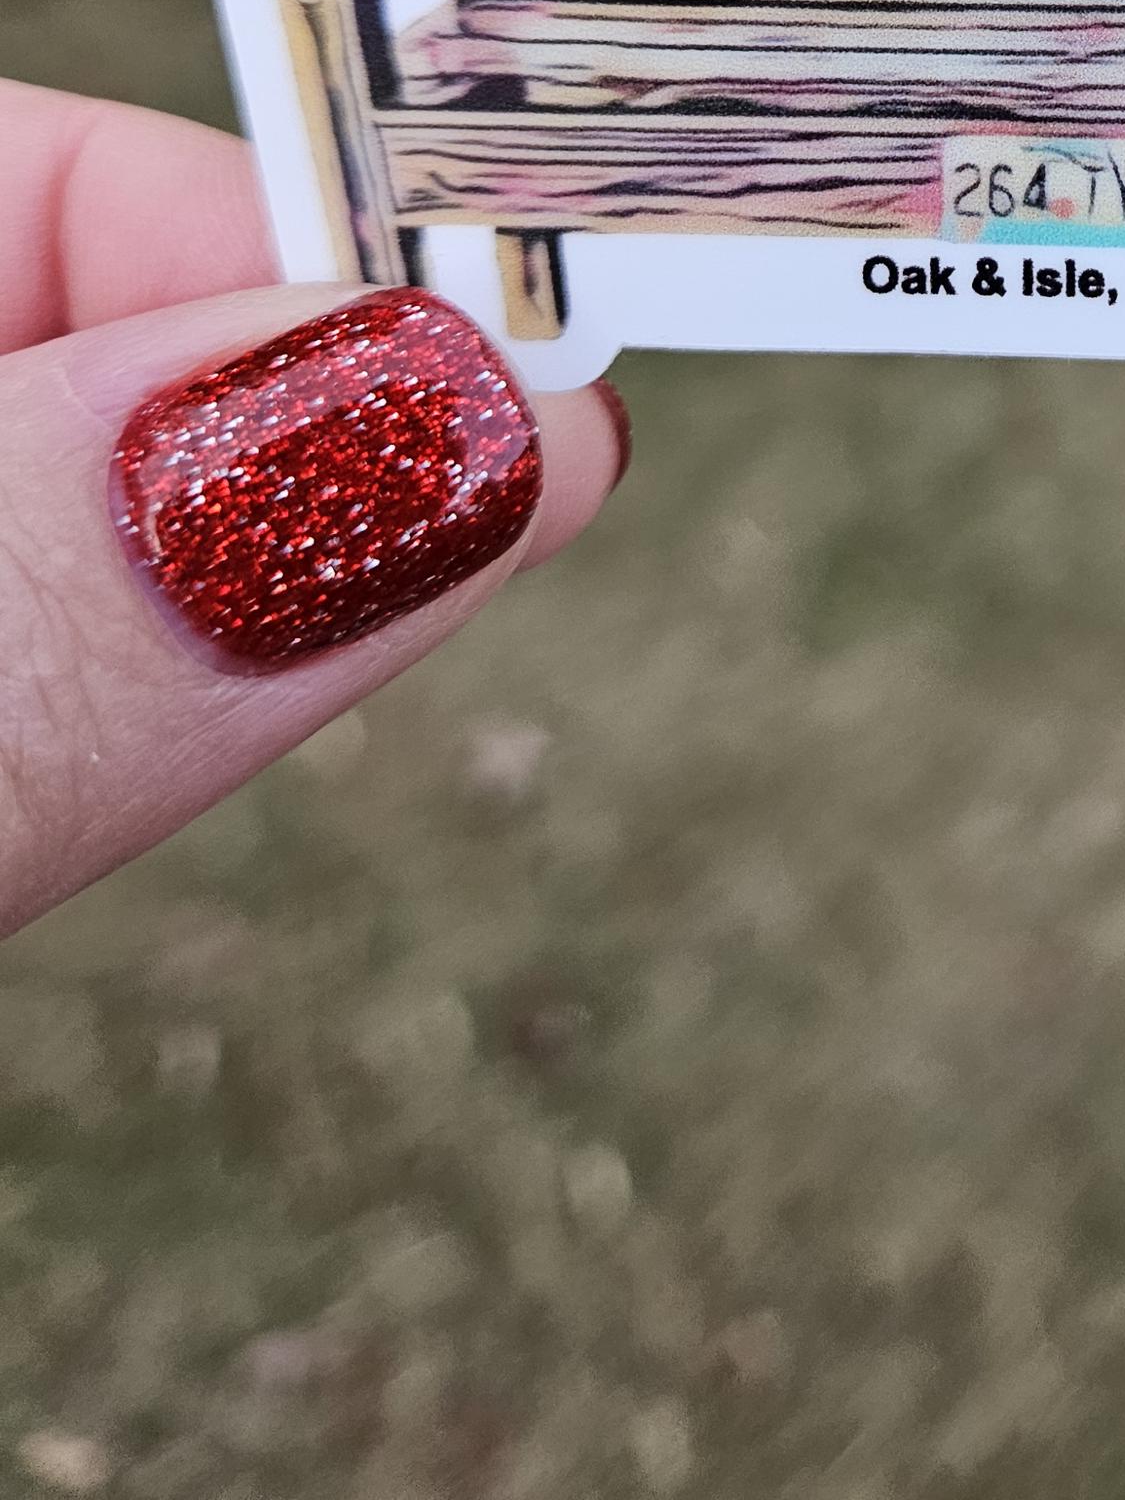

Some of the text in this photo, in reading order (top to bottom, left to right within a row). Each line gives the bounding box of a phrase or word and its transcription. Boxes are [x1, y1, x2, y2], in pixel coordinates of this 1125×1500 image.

[953, 162, 1048, 218] 264
[862, 255, 957, 296] Oak
[971, 257, 1006, 297] &
[1022, 258, 1118, 305] Isle,
